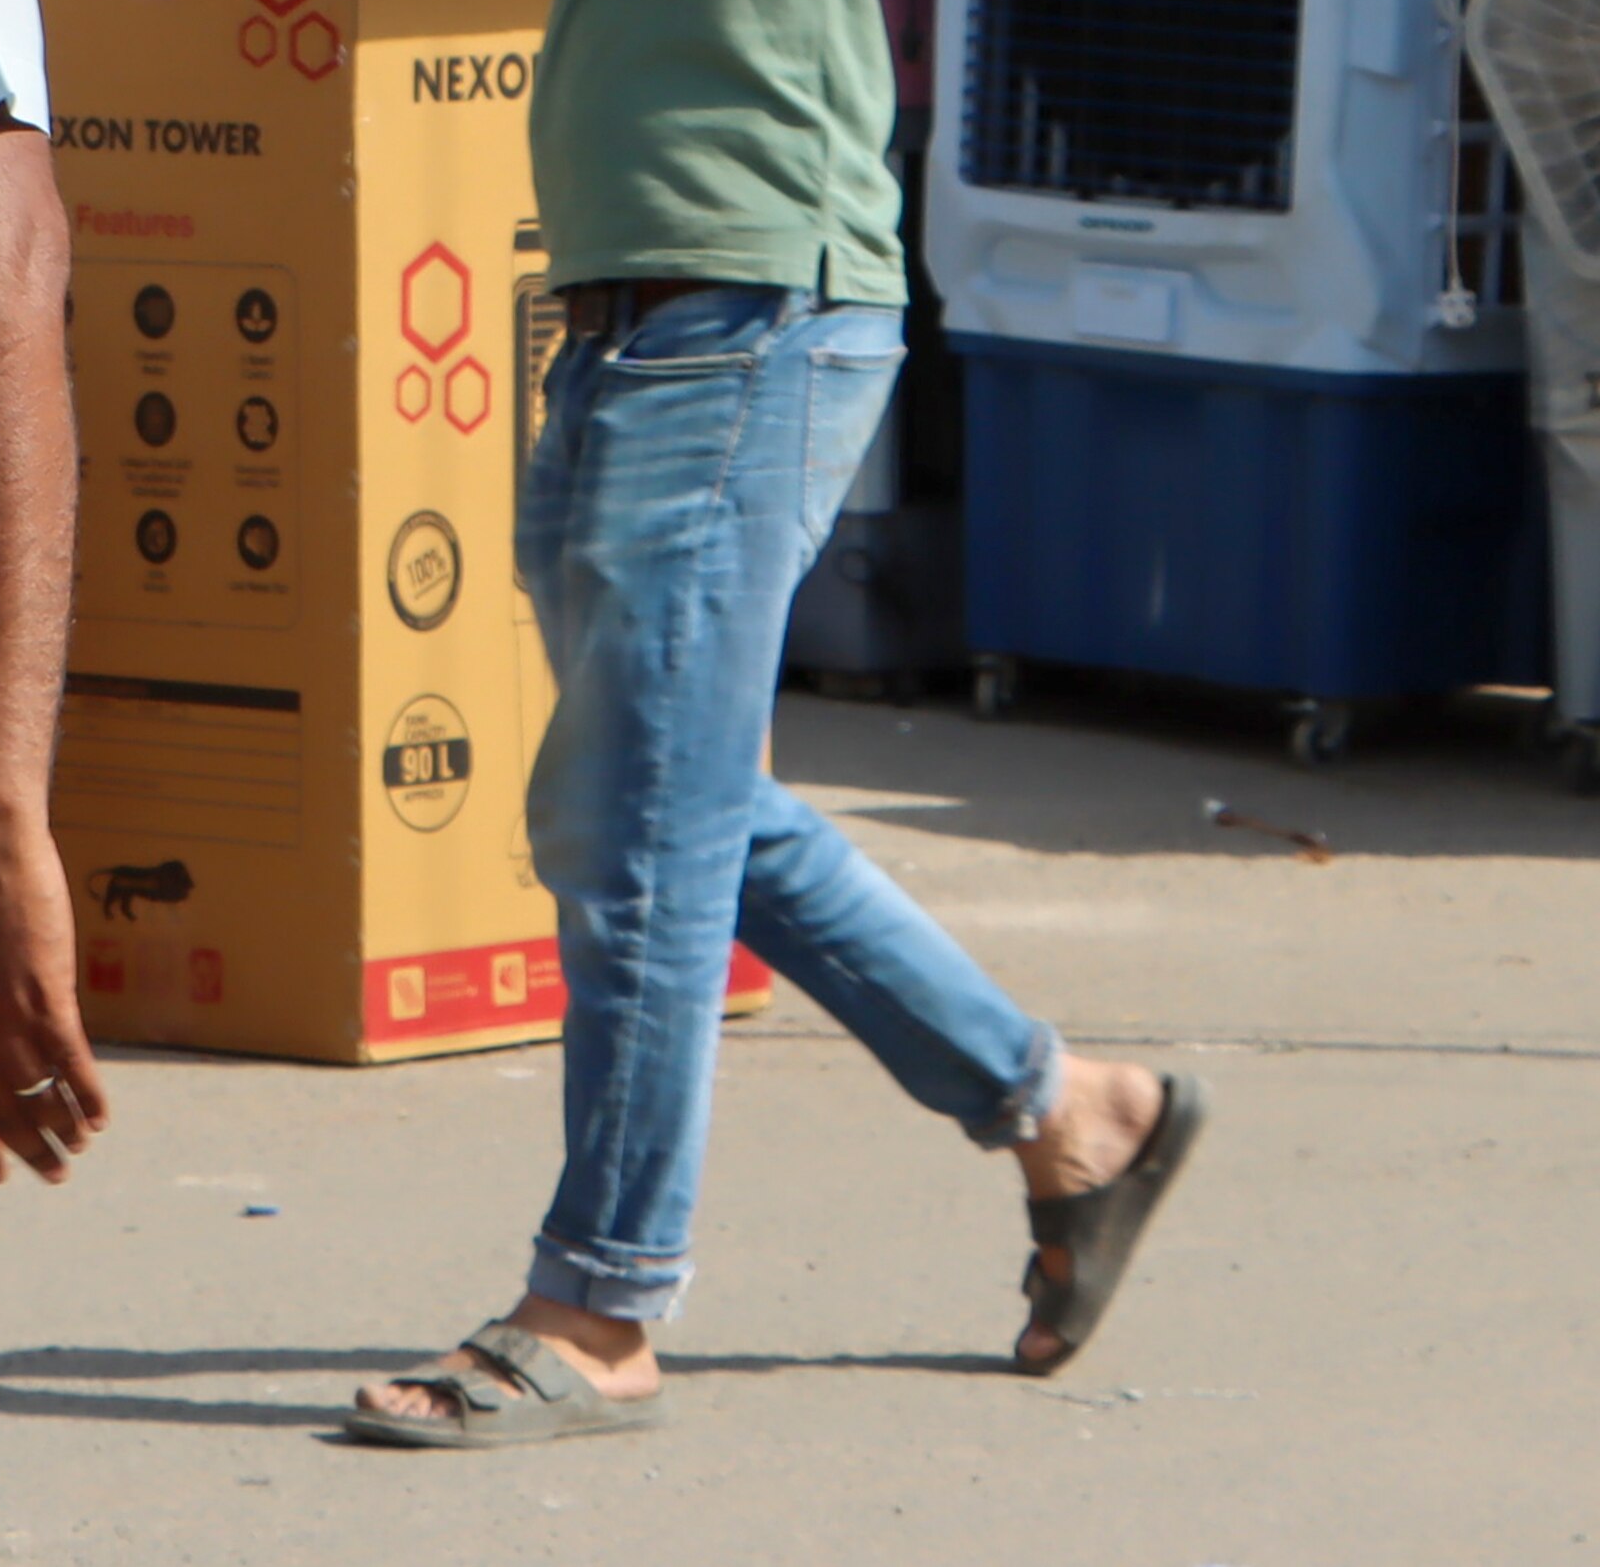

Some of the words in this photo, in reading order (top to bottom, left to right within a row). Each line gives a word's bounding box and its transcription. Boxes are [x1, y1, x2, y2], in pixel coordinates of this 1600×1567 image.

[145, 121, 262, 157] TOWER
[76, 204, 195, 239] Features
[402, 745, 433, 783] 90
[438, 741, 455, 778] L
